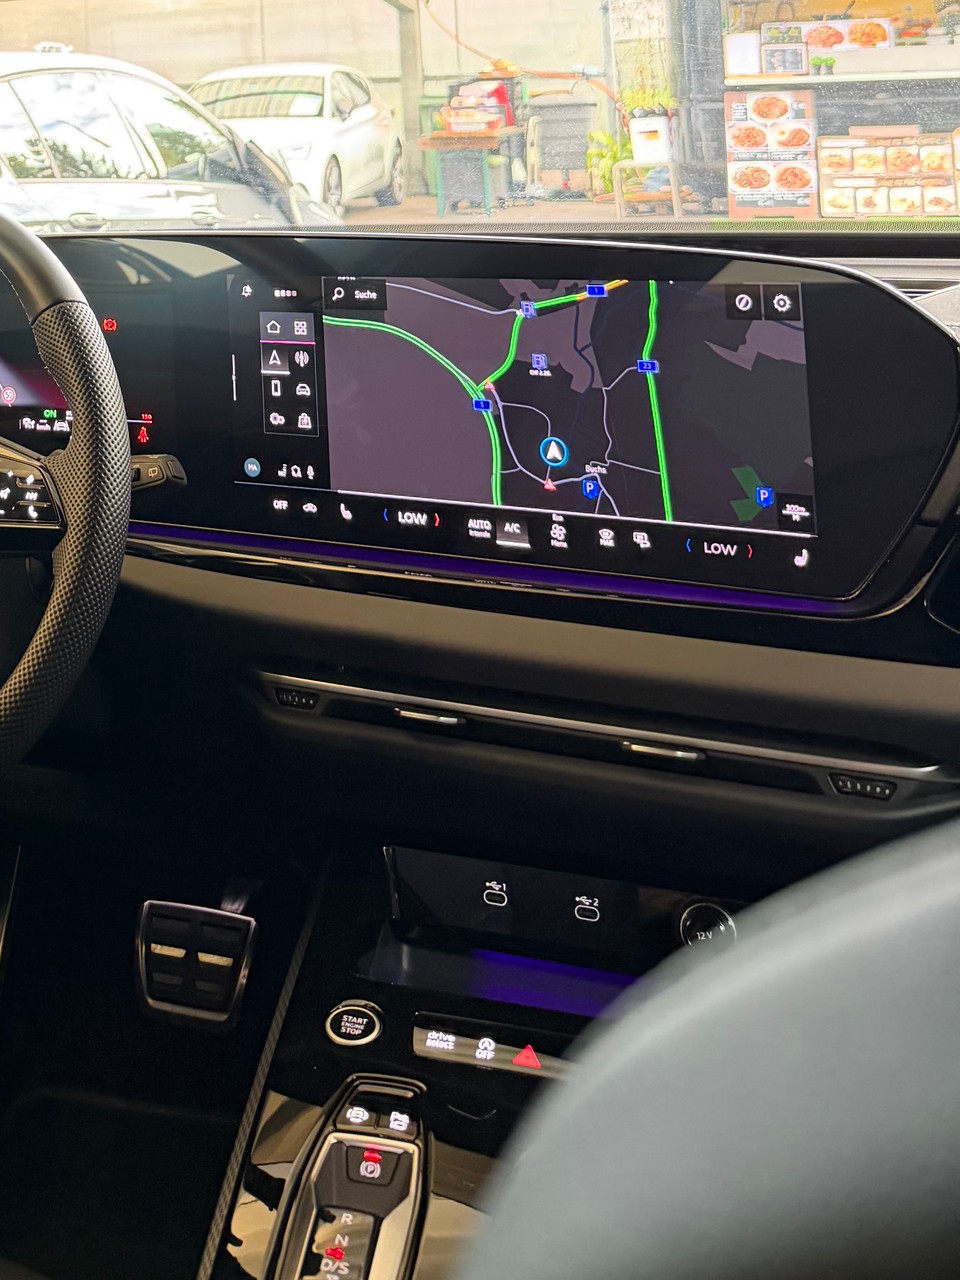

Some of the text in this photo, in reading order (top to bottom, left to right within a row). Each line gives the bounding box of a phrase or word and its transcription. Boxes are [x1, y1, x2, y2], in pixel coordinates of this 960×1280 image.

[354, 290, 377, 299] Suche
[43, 409, 57, 418] ON
[273, 499, 288, 510] OFF
[397, 511, 428, 525] LOW
[467, 518, 492, 530] AUTO
[504, 522, 521, 534] A/C
[703, 542, 737, 556] LOW
[593, 898, 599, 907] 2
[341, 1021, 365, 1031] ENGINE
[342, 1014, 369, 1026] START
[341, 1026, 363, 1036] STOP
[427, 1030, 456, 1042] drive
[426, 1038, 455, 1050] select
[475, 1049, 495, 1060] OFF
[340, 1213, 353, 1225] R
[334, 1233, 350, 1247] N
[320, 1258, 350, 1276] D/S
